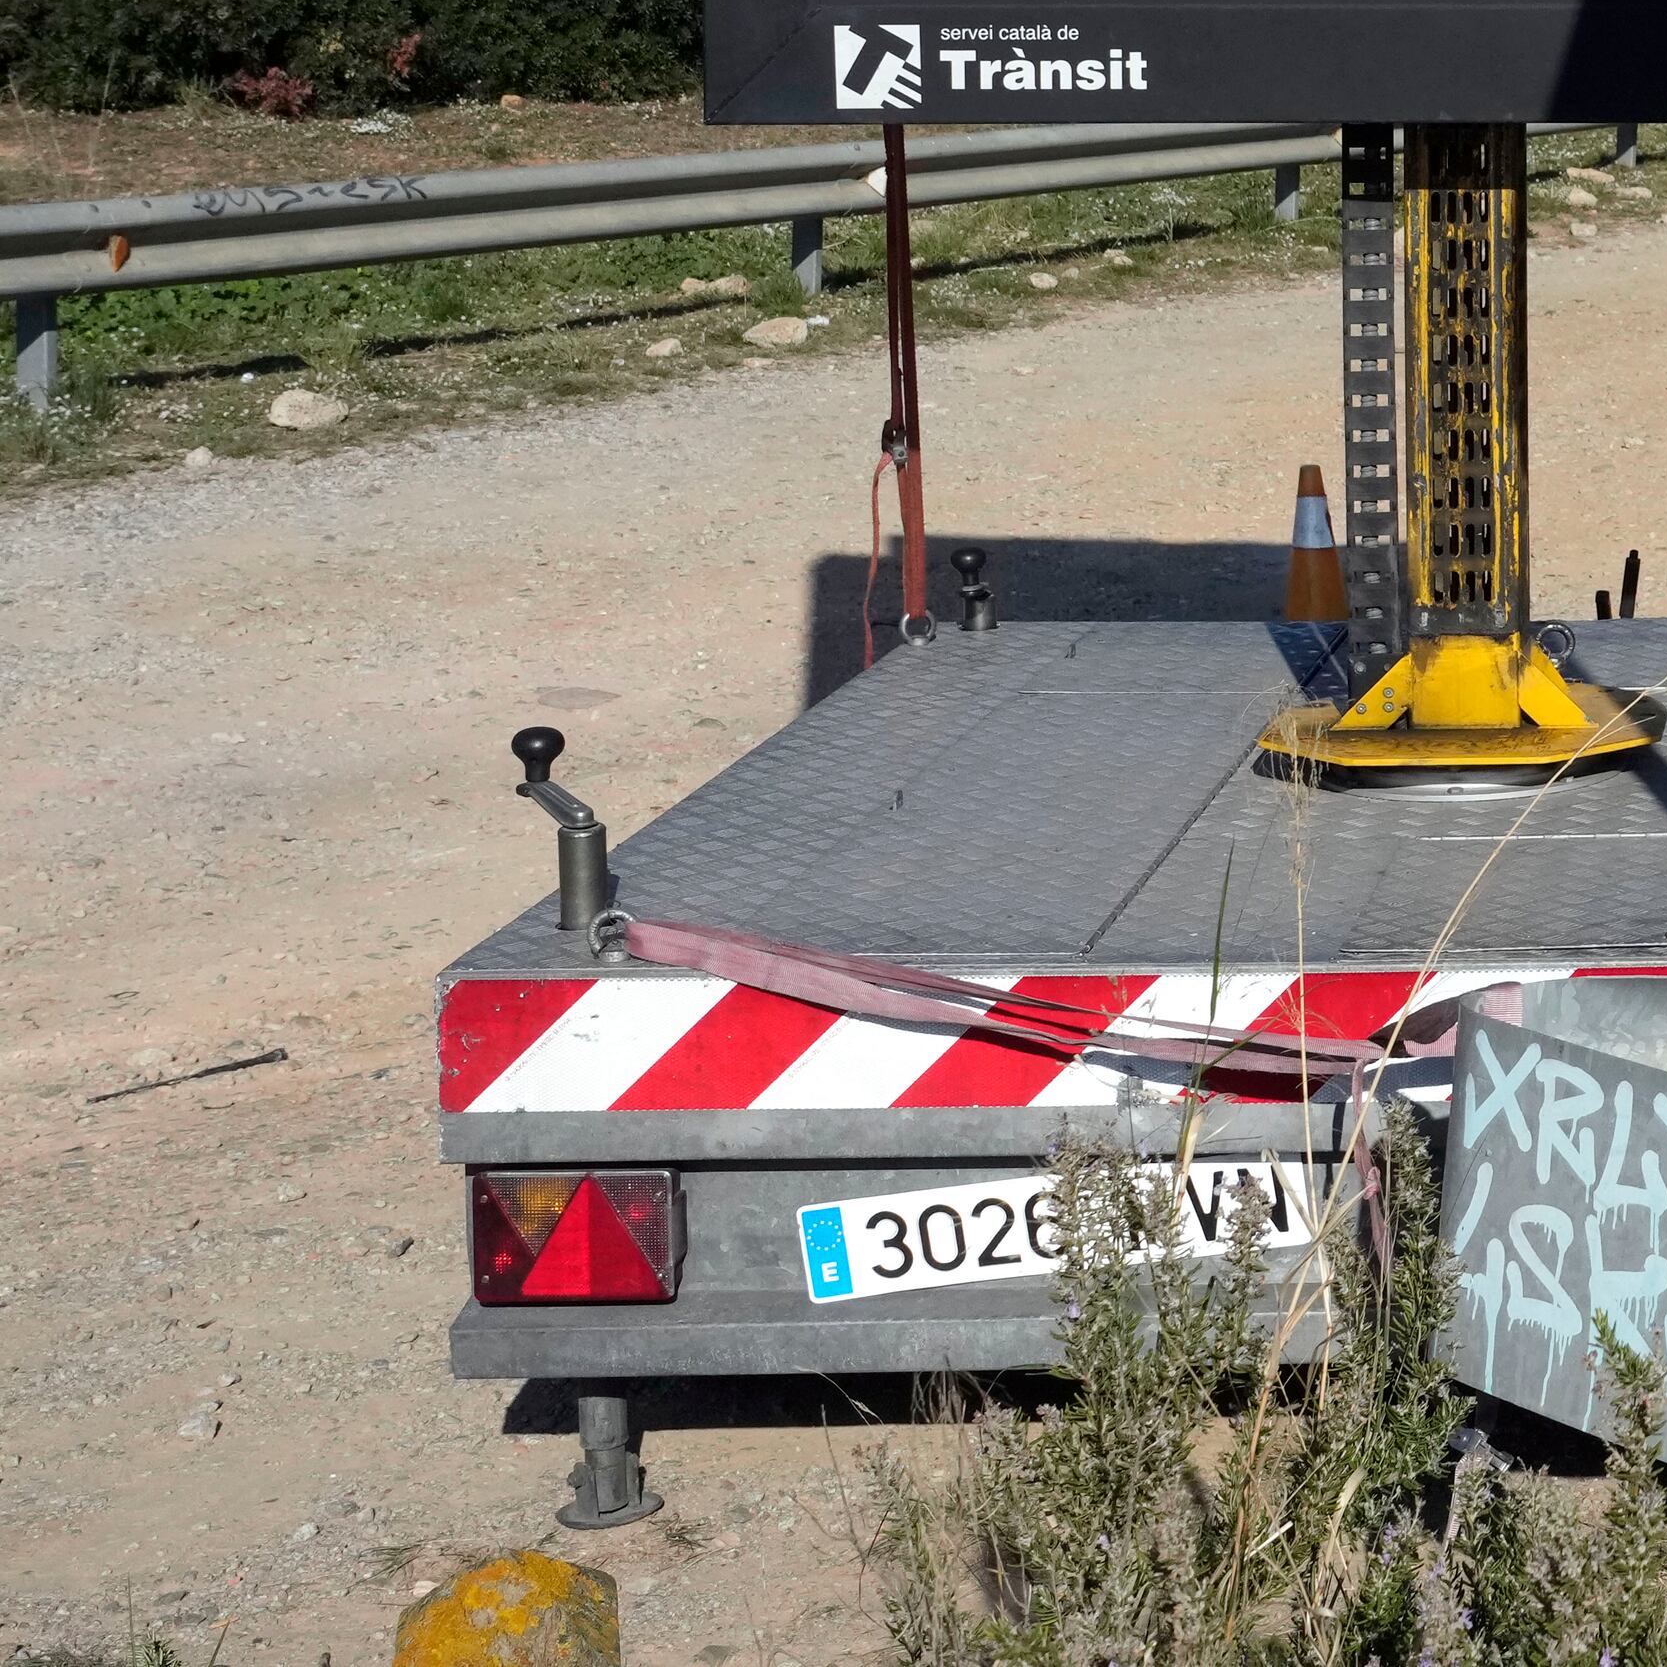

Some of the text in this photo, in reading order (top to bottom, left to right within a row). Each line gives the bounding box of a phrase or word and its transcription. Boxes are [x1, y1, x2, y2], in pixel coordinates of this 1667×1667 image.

[940, 24, 1080, 41] servei català de
[939, 46, 1148, 91] Trànsit
[821, 1261, 840, 1283] E
